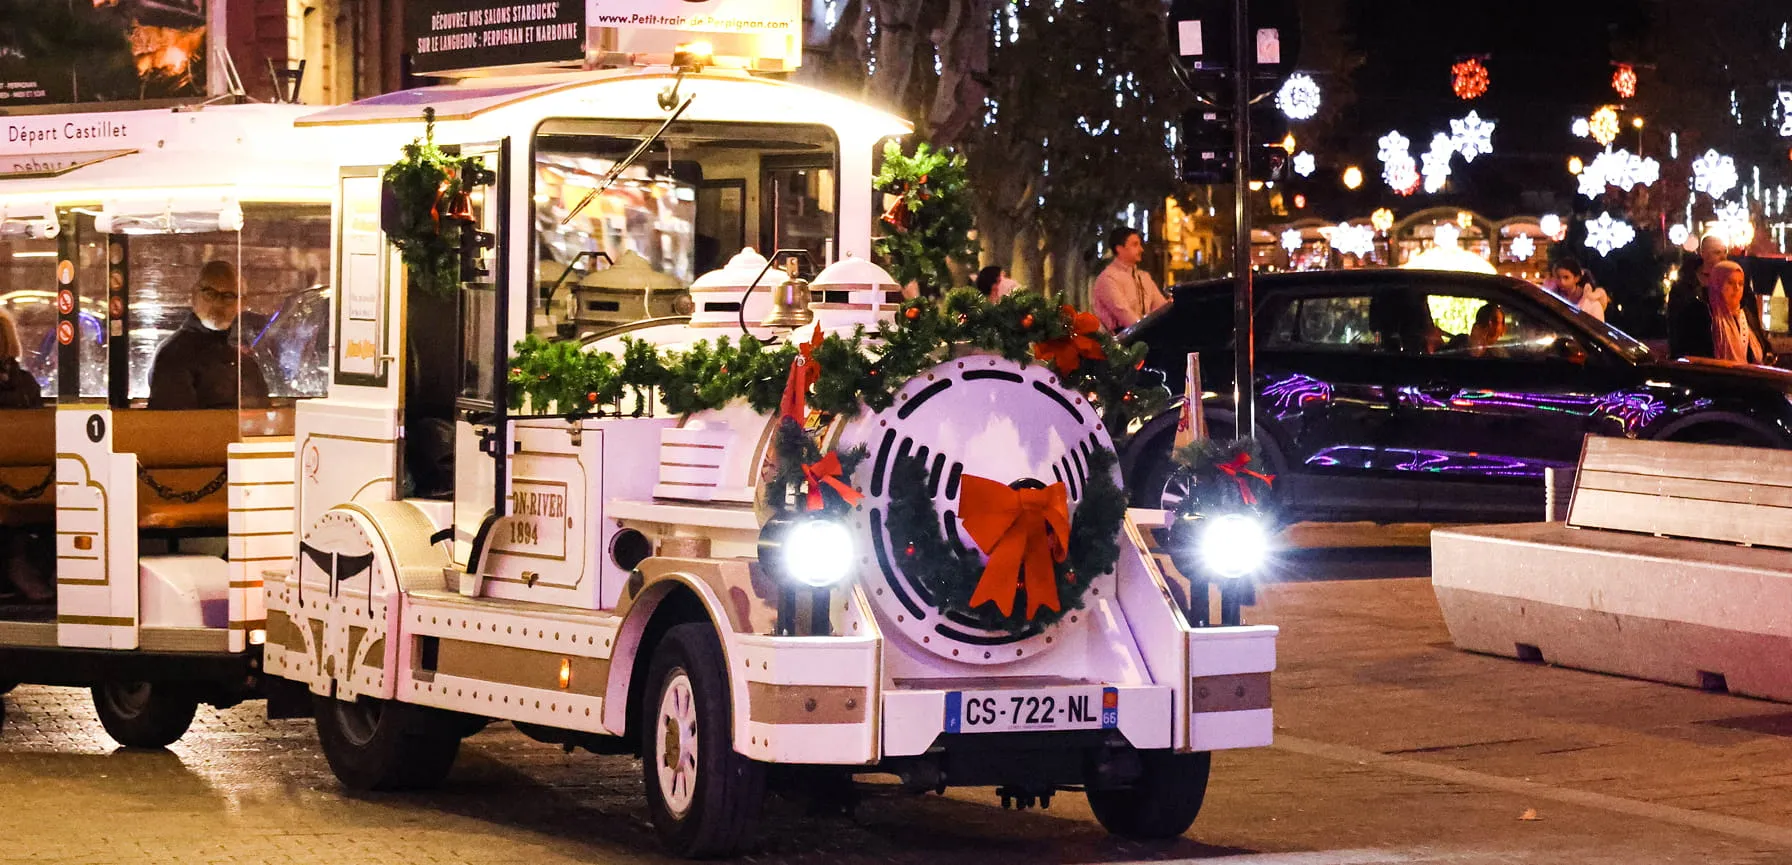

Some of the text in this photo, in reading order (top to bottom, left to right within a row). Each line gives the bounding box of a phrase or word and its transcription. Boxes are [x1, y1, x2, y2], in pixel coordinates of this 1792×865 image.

[431, 11, 468, 31] DÉCOUVREZ
[469, 10, 483, 27] NOS
[484, 7, 511, 25] SALONS
[599, 14, 686, 27] www.Petit-train
[417, 37, 431, 54] SUR
[431, 36, 439, 52] LE
[440, 32, 478, 51] LANGUEDOC
[483, 27, 523, 47] PERPIGNAN
[525, 26, 534, 43] ET
[536, 22, 578, 41] NARBONNE
[9, 121, 127, 148] Départ Castillet
[91, 419, 99, 437] 1
[510, 520, 538, 545] 1894
[966, 695, 1097, 726] CS-722-NL
[1103, 711, 1117, 725] 66
